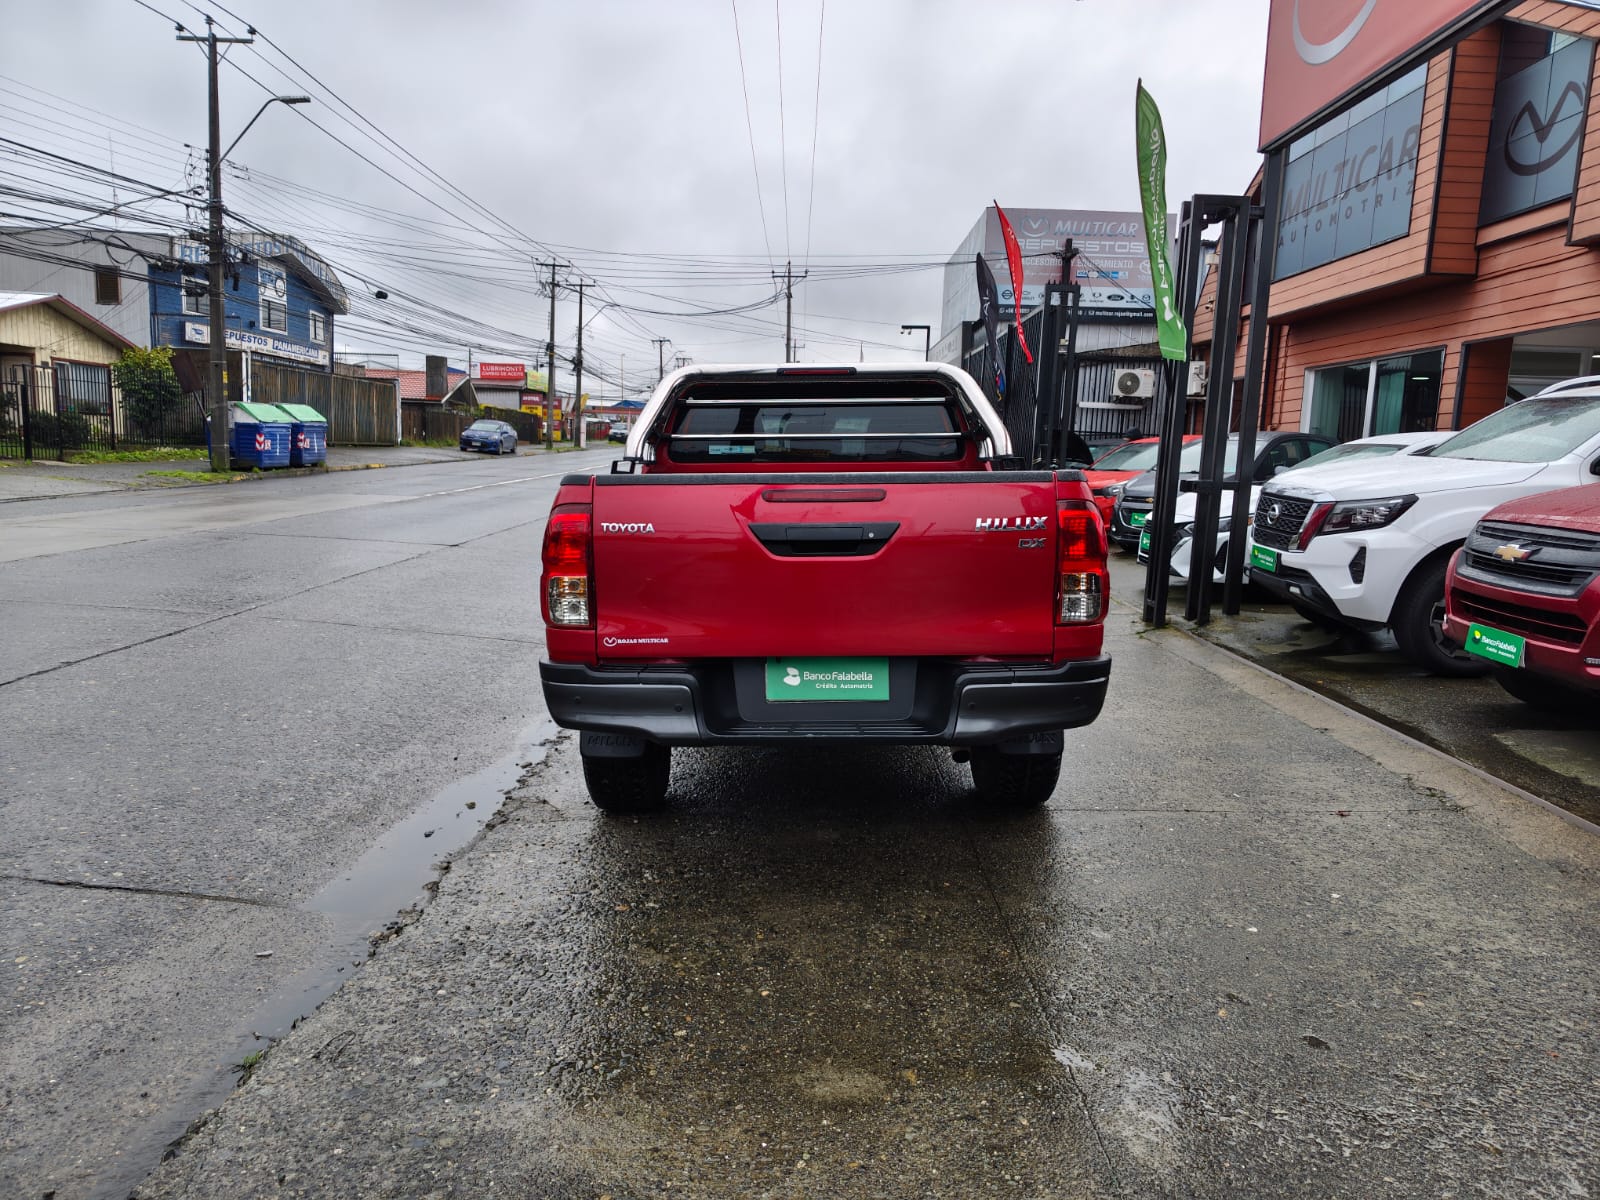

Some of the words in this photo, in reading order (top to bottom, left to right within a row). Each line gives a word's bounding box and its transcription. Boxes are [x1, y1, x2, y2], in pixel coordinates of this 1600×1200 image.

[1282, 124, 1420, 226] MULTICAR
[1279, 179, 1415, 248] AUTOMOTRIZ
[1054, 219, 1139, 238] MULTICAR
[601, 522, 655, 533] TOYOTA
[975, 516, 1048, 532] HILUX
[1018, 537, 1047, 548] DX
